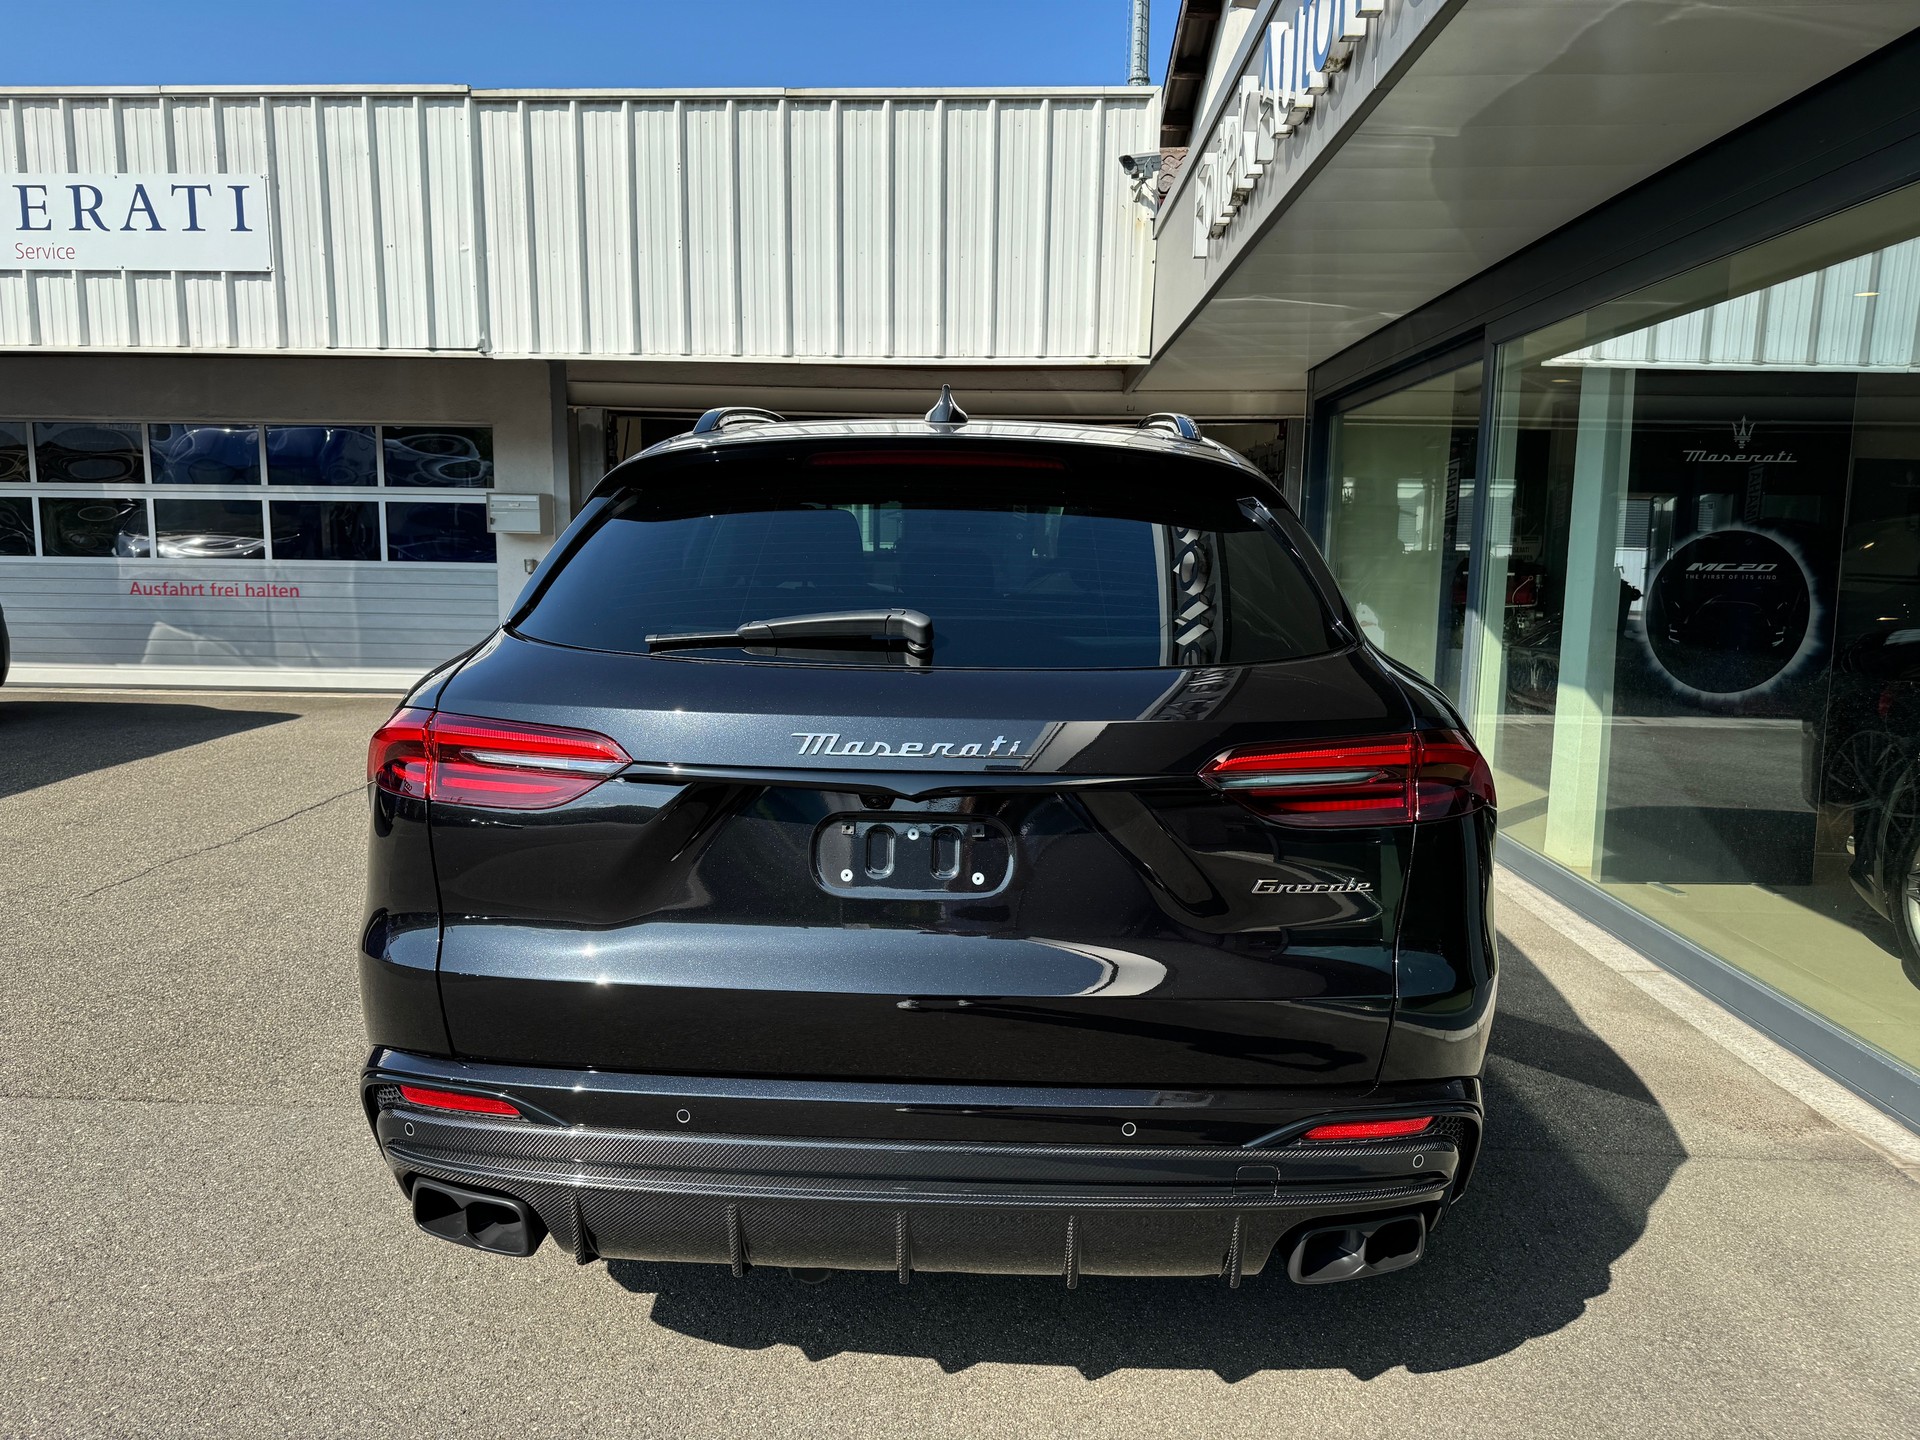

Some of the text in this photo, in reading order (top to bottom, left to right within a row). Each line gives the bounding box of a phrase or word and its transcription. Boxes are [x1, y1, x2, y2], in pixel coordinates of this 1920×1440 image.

[12, 183, 254, 232] ERATI
[14, 242, 76, 260] Service
[1682, 449, 1798, 463] Maserati
[1685, 562, 1778, 572] MC20
[129, 581, 300, 598] Ausfahrt frei halten
[791, 732, 1034, 759] Maserati
[1251, 877, 1374, 894] Grecale
